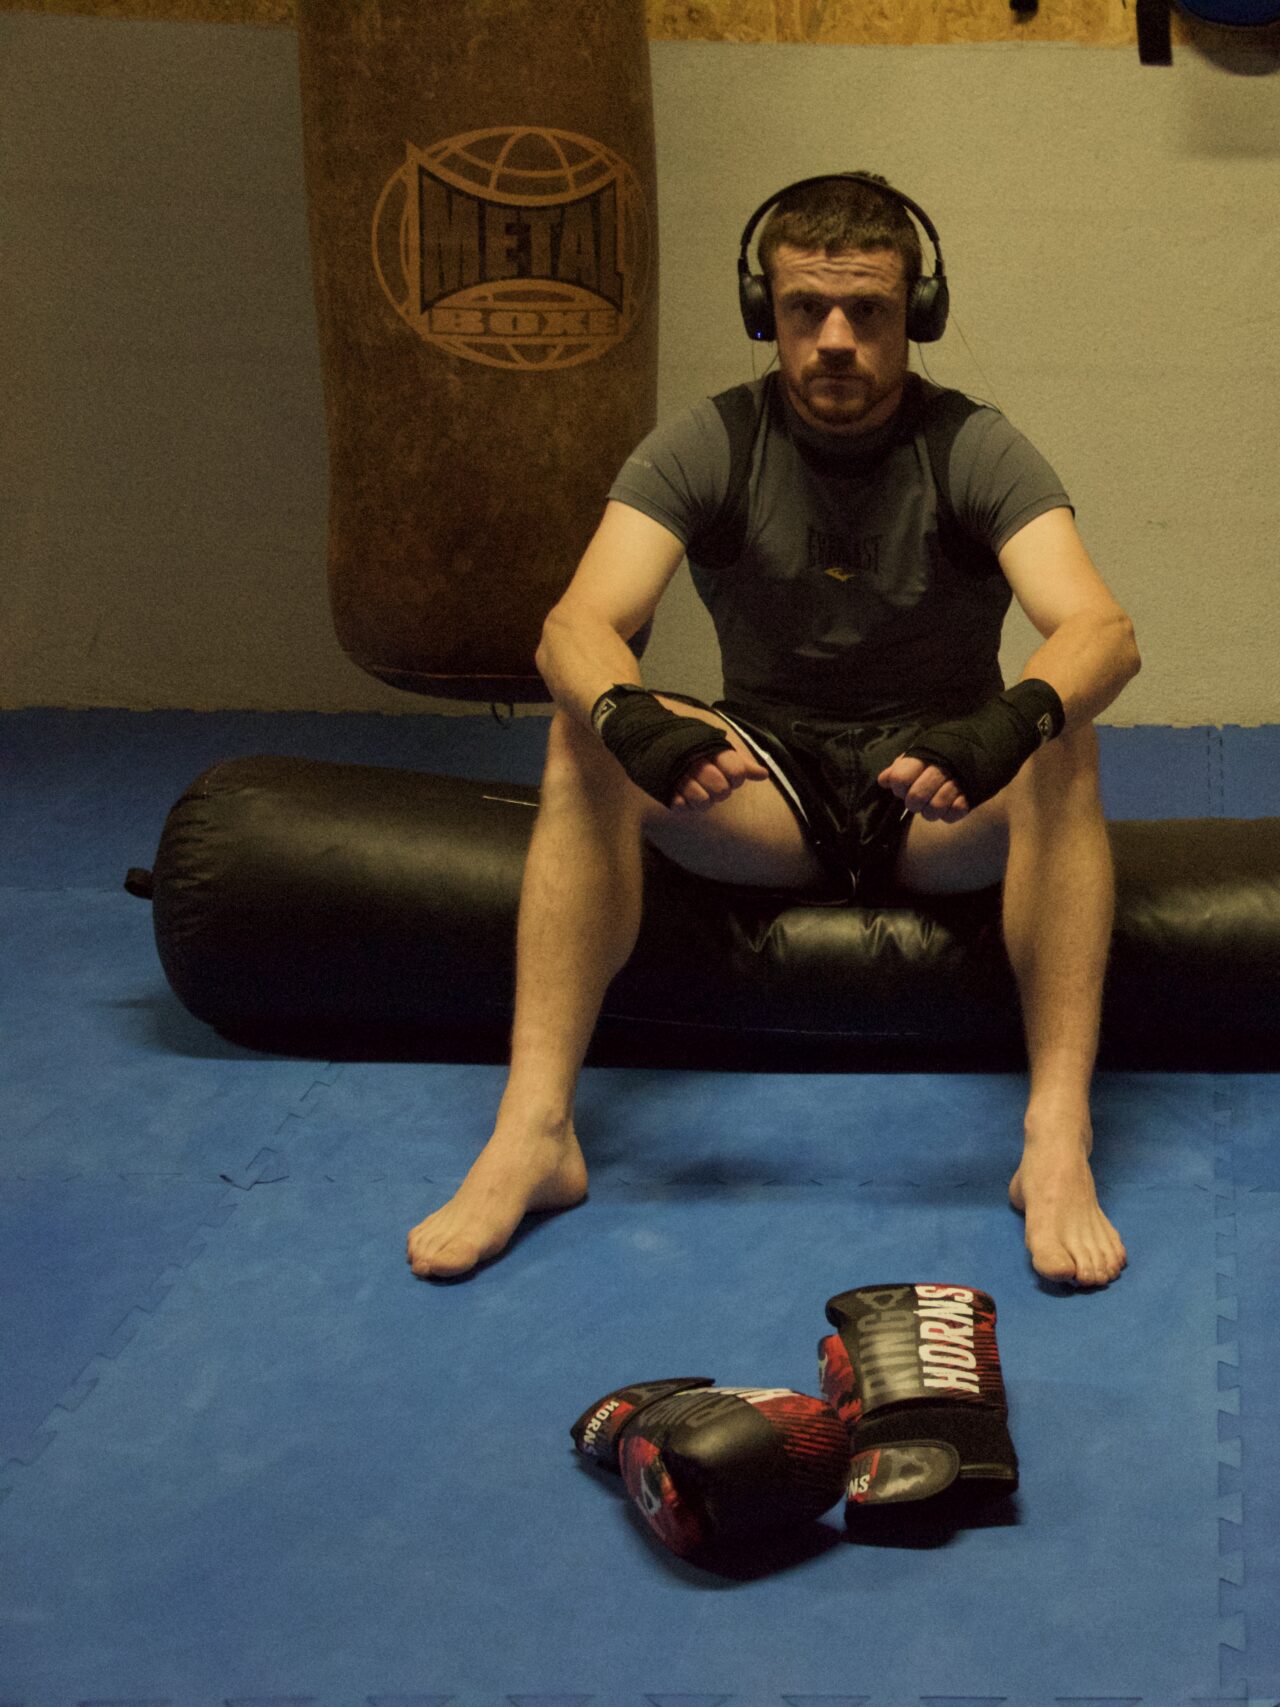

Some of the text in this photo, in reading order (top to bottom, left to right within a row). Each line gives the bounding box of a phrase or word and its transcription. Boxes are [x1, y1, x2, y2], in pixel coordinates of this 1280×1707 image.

[418, 165, 624, 313] METAL
[430, 308, 619, 337] BOXE
[913, 1285, 980, 1394] HORNS
